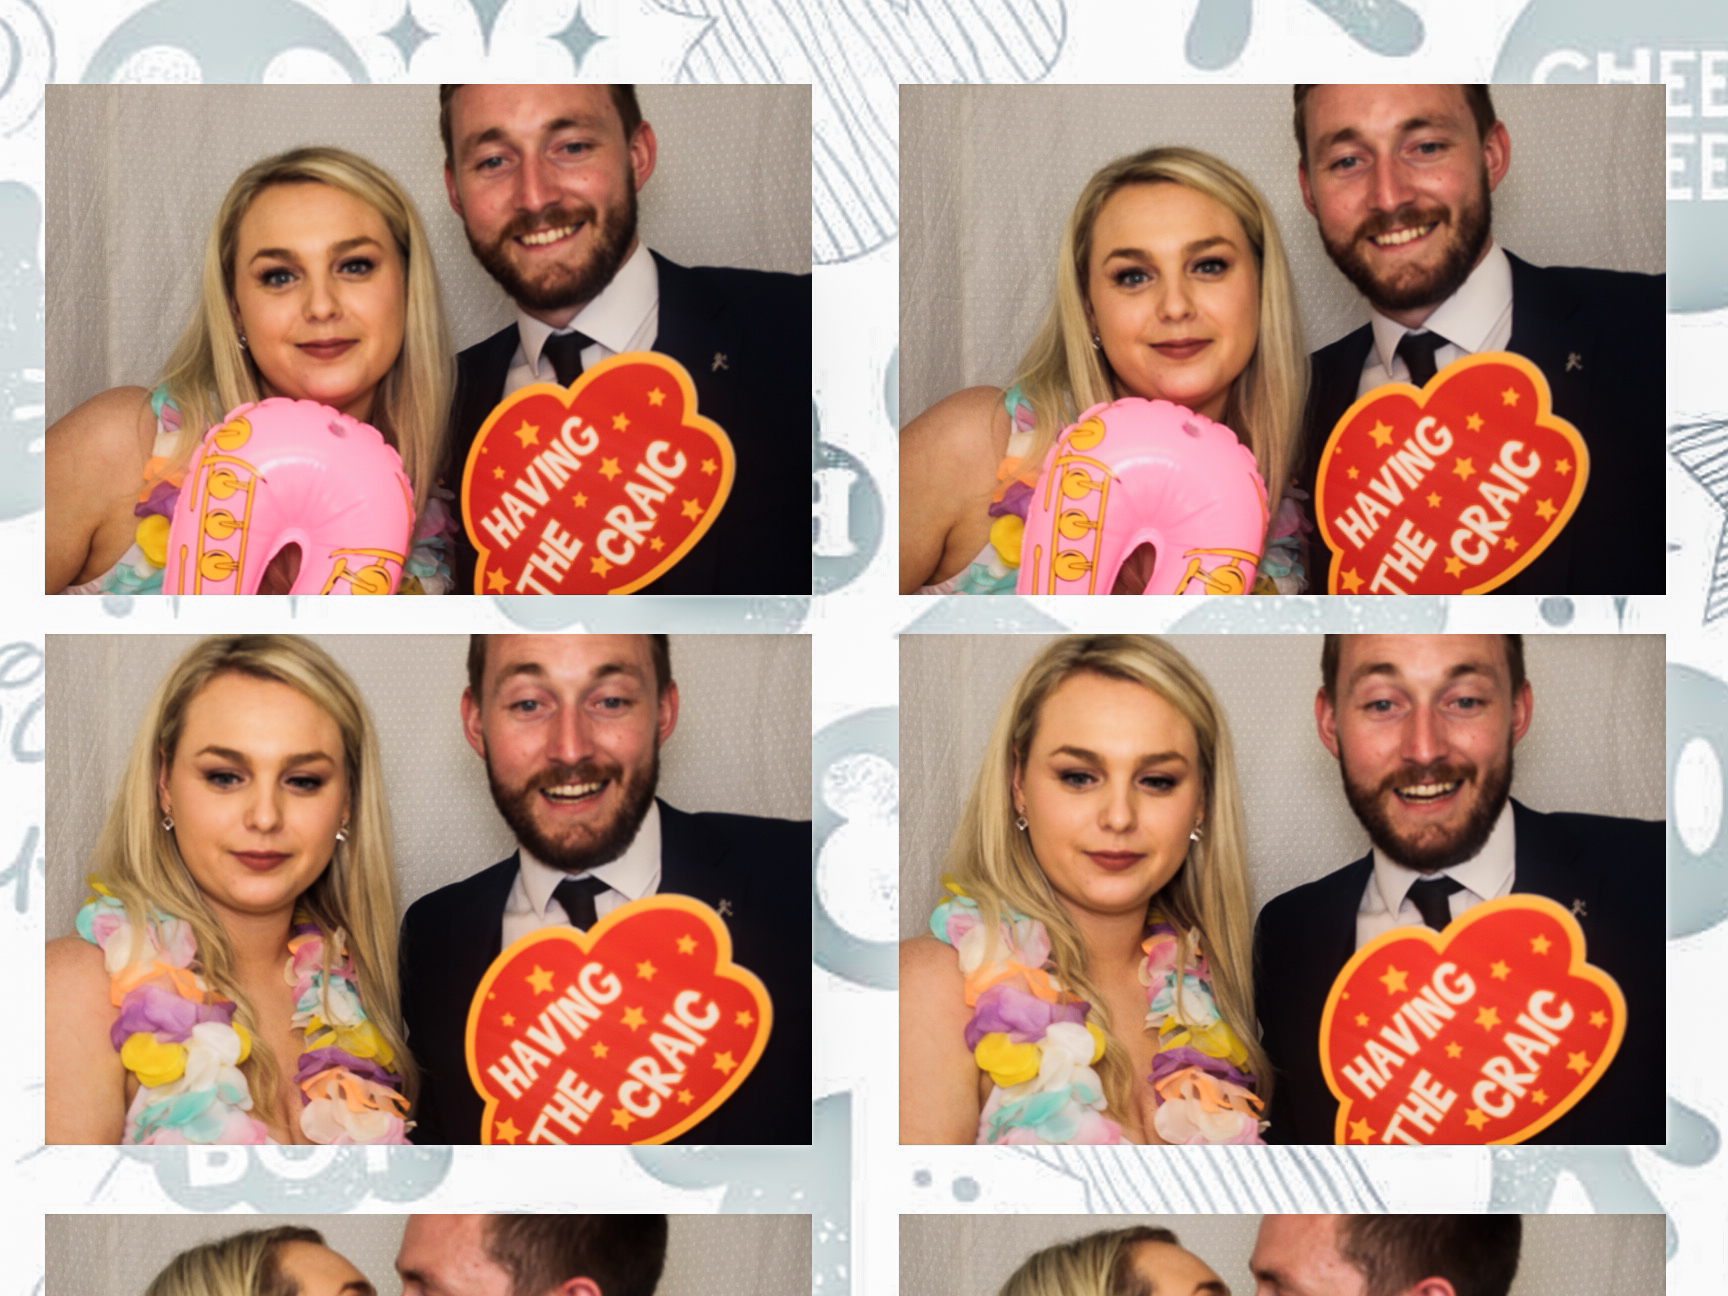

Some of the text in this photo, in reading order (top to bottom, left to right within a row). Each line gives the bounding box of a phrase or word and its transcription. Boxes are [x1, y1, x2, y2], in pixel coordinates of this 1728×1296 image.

[480, 415, 600, 550] HAVING
[514, 440, 688, 594] THE CRAIC
[1334, 415, 1454, 550] HAVING
[1368, 440, 1542, 594] THE CRAIC
[487, 961, 623, 1100] HAVING
[526, 989, 721, 1144] THE CRAIC
[1341, 961, 1477, 1100] HAVING
[1380, 989, 1575, 1144] THE CRAIC
